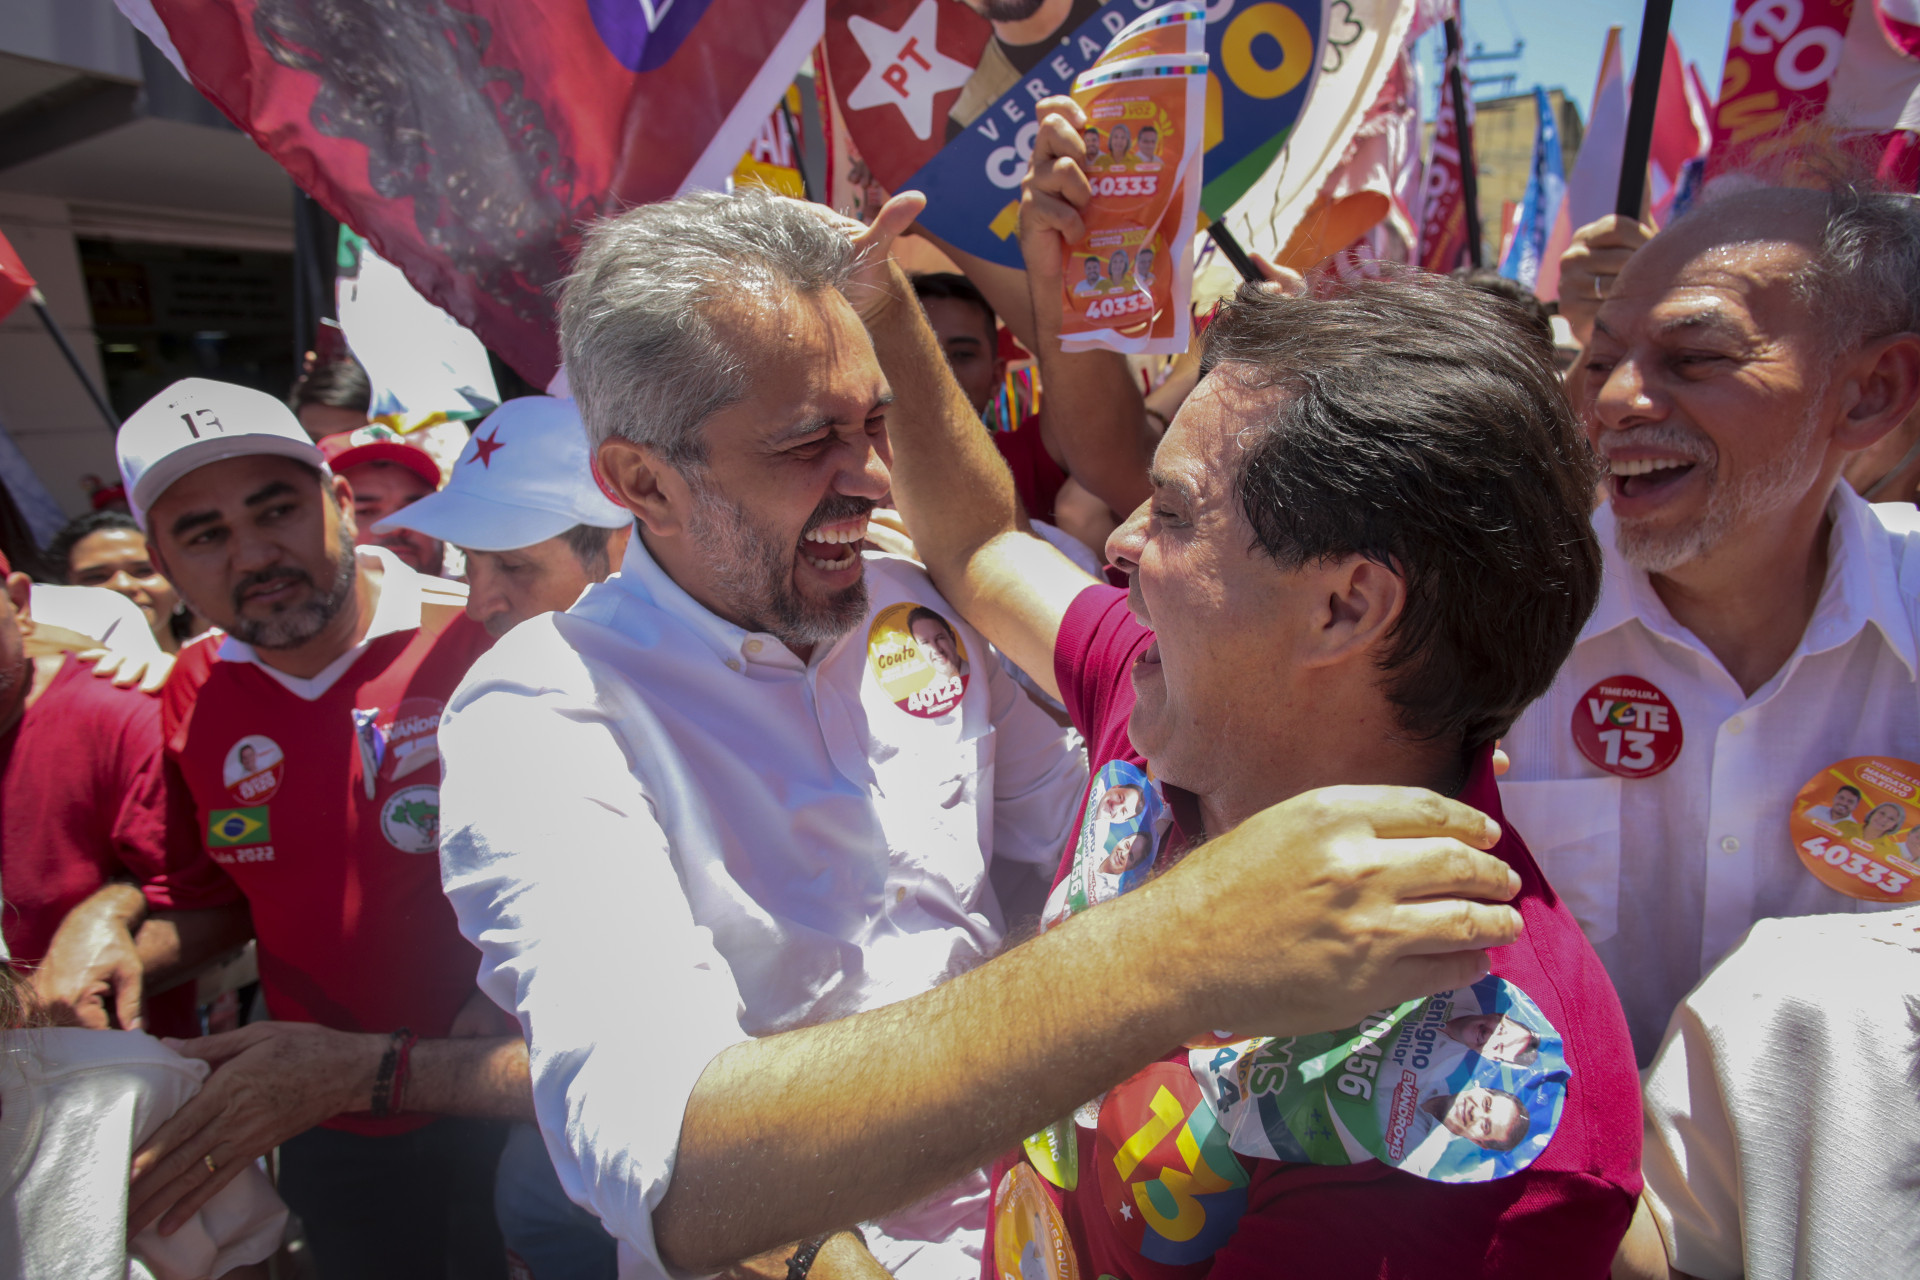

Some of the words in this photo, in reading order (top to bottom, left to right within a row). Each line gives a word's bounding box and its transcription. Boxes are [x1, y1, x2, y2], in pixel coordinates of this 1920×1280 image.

[881, 36, 933, 99] PT
[1085, 292, 1153, 319] 40333
[878, 645, 916, 669] Couto
[907, 675, 964, 712] 40123
[1600, 686, 1621, 697] TIME
[1622, 688, 1637, 698] DO
[1637, 689, 1660, 701] LULA
[1587, 697, 1670, 733] VOTE
[1597, 728, 1656, 770] 13
[1860, 772, 1909, 798] COLETIVO
[1863, 766, 1914, 793] MANDATO
[1801, 836, 1912, 894] 40333
[1392, 1019, 1420, 1067] Junior
[1392, 1070, 1417, 1137] EVANDRO
